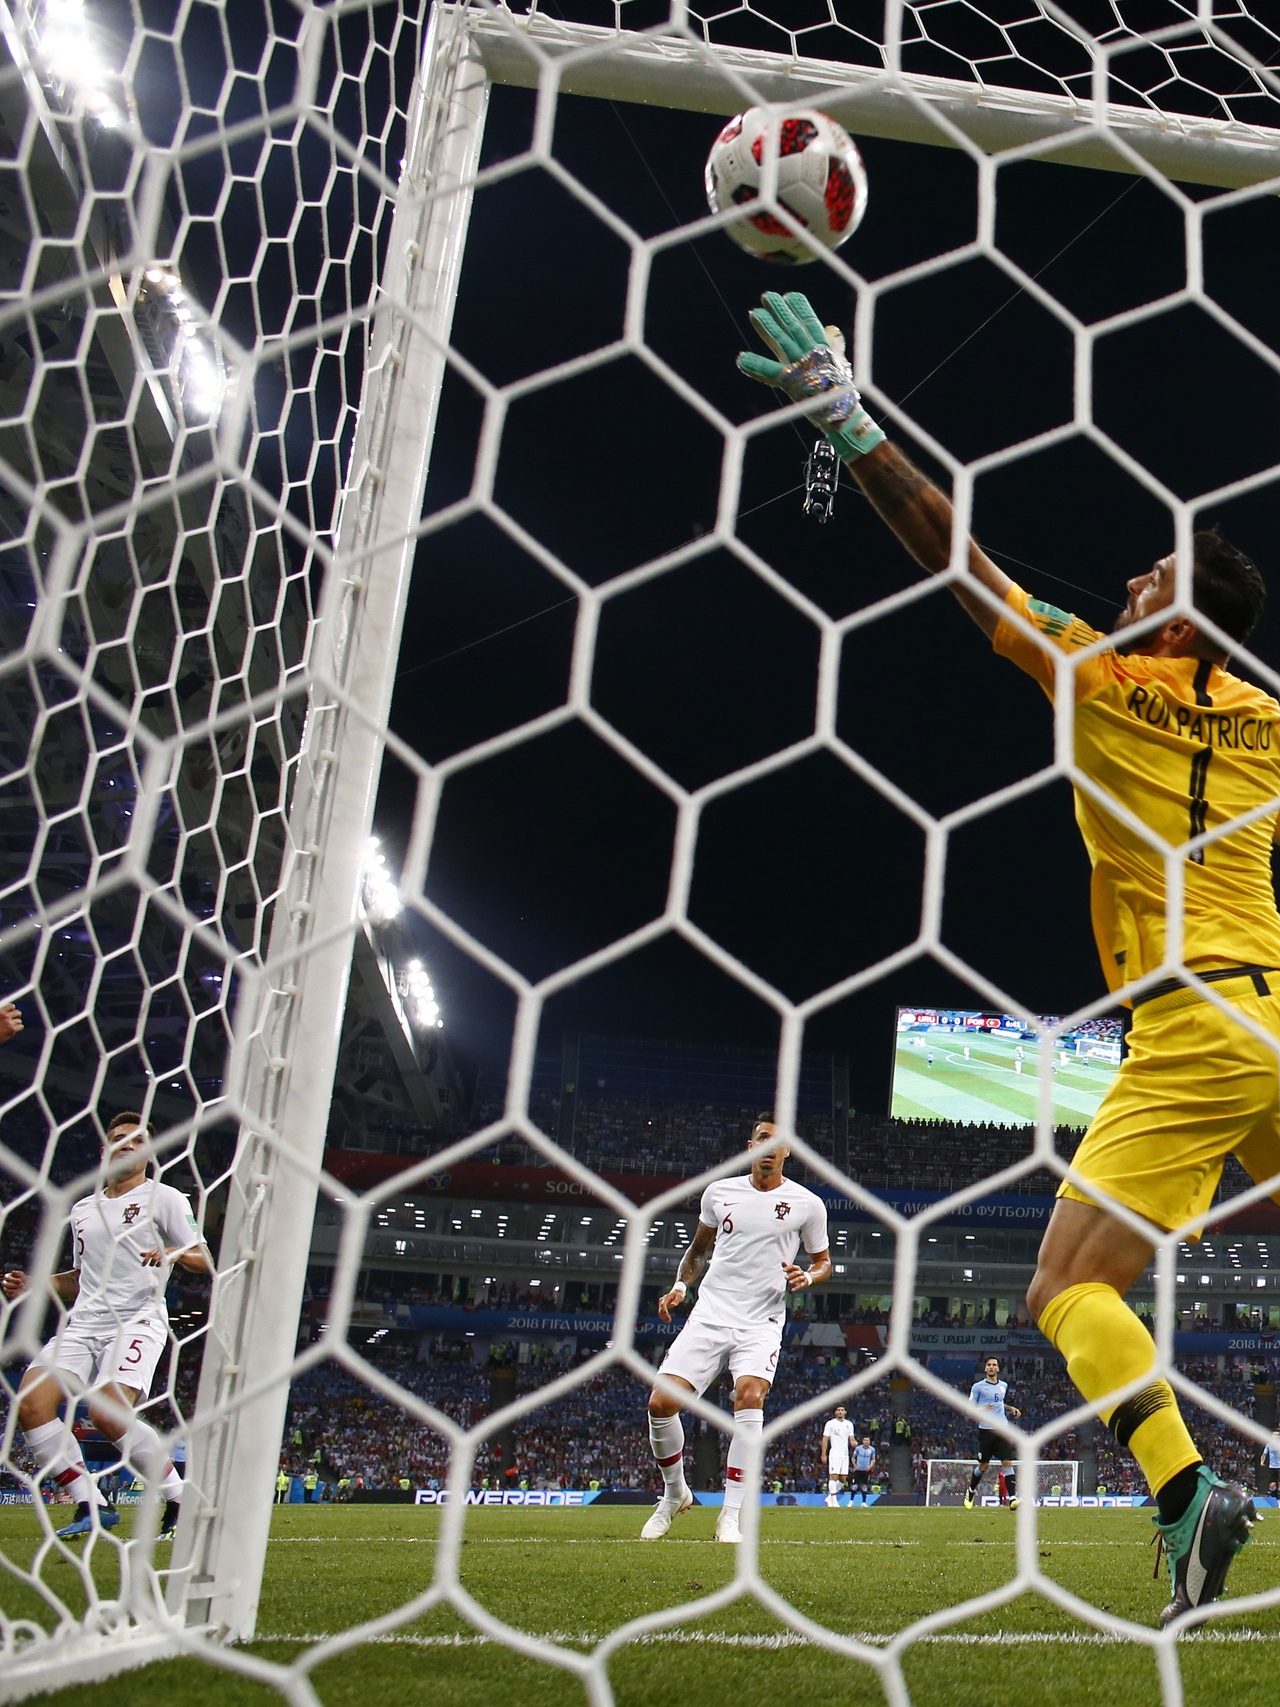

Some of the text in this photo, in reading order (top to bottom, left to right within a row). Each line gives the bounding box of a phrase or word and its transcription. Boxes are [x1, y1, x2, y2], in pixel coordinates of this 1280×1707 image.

[1127, 685, 1170, 729] RUI
[1189, 745, 1214, 865] 1
[917, 1015, 936, 1024] URU
[967, 1018, 985, 1027] POR
[545, 1180, 595, 1196] SOCH
[976, 1206, 1045, 1219] ФУТБОЛУ
[722, 1211, 734, 1235] 6
[507, 1316, 540, 1329] 2018
[541, 1318, 571, 1331] FIFA
[573, 1320, 616, 1332] WORL
[656, 1323, 684, 1335] RUS
[911, 1333, 939, 1344] VAMOS
[943, 1335, 977, 1345] URUGUAY
[1228, 1339, 1256, 1350] 2018
[125, 1339, 144, 1364] 5
[994, 1392, 999, 1403] 6
[116, 1491, 144, 1505] Hisens
[414, 1489, 585, 1506] POWERADE
[981, 1495, 1134, 1507] PERADE
